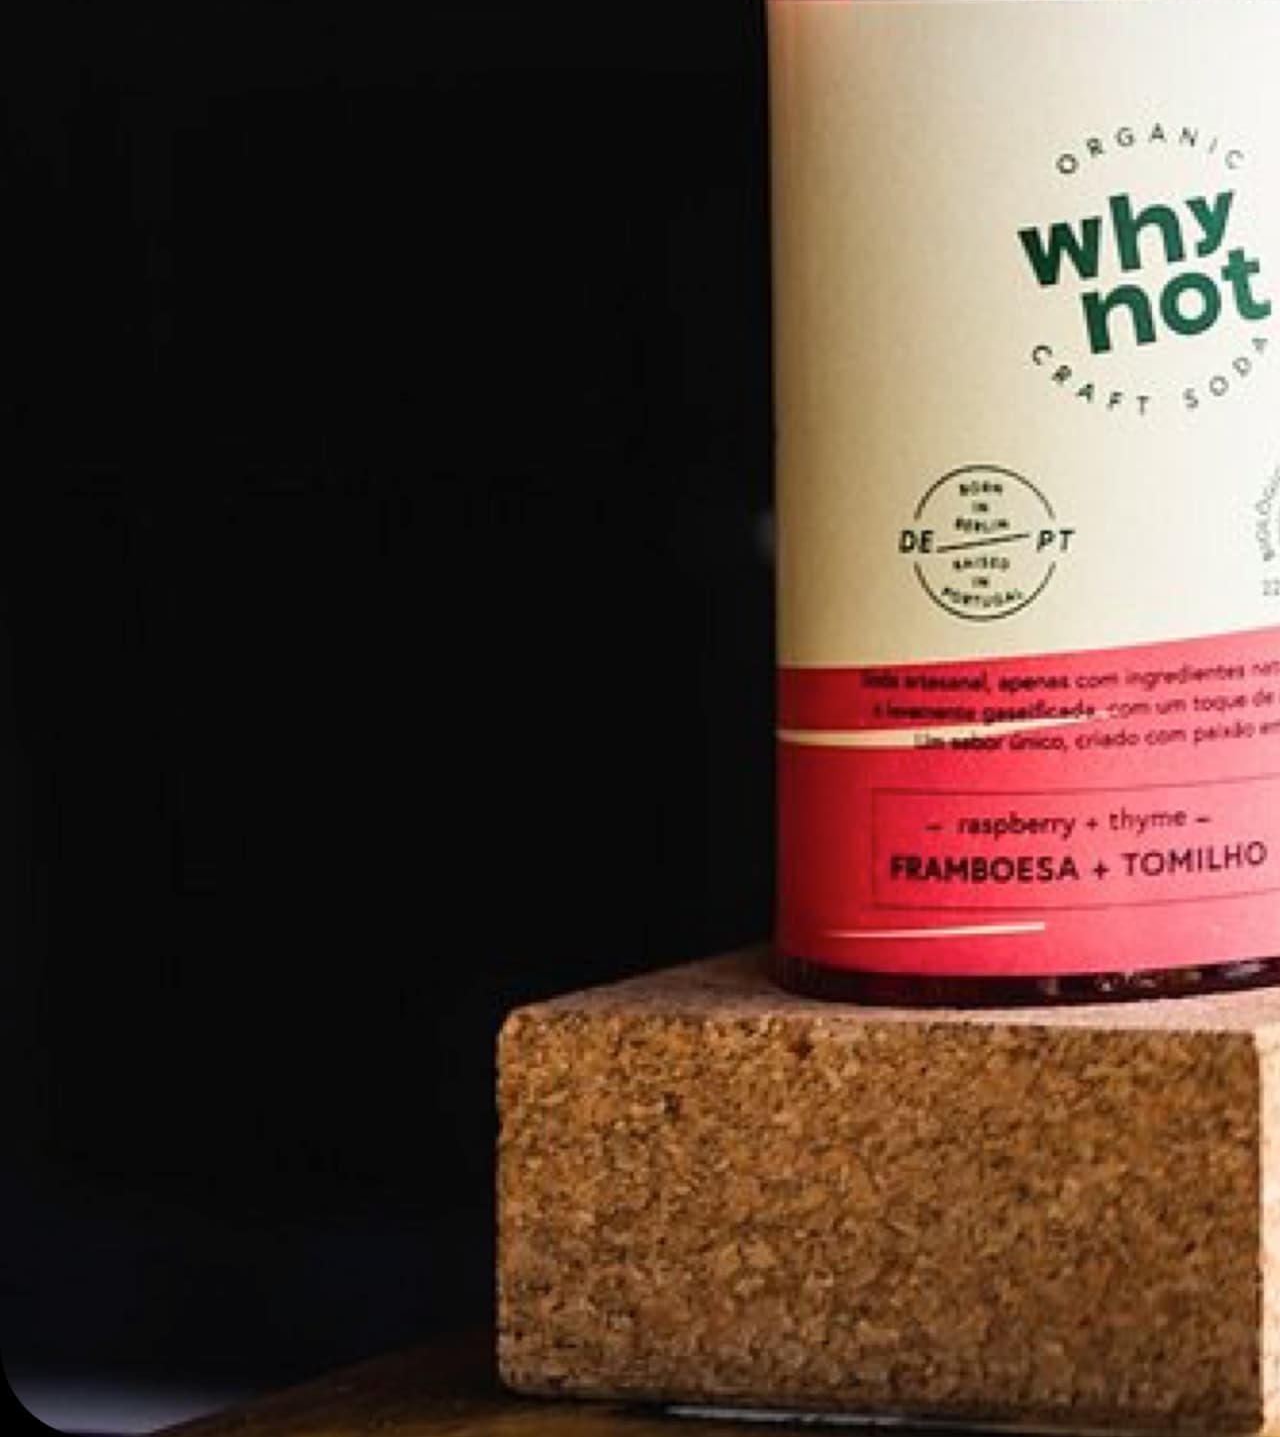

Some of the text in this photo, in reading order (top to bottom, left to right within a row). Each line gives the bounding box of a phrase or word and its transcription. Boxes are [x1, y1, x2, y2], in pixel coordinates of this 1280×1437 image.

[1055, 122, 1245, 176] ORGANIC
[1016, 188, 1235, 288] why
[1080, 246, 1273, 355] not
[1031, 336, 1270, 416] CRAFT SODA
[898, 528, 1077, 554] DE PT
[998, 673, 1070, 695] apenas
[1075, 673, 1119, 690] com
[1124, 663, 1245, 692] ingredientes
[1109, 701, 1150, 719] com
[1155, 697, 1187, 714] um
[1193, 694, 1247, 715] toque
[1251, 688, 1275, 708] de
[951, 732, 1003, 751] sabor
[1008, 730, 1070, 754] único,
[1074, 727, 1139, 749] criado
[1144, 728, 1187, 746] com
[1193, 721, 1256, 750] paixão
[957, 810, 1077, 842] raspberry
[1108, 806, 1189, 837] thyme
[889, 839, 1270, 885] FRAMBOESA + TOMILHO
